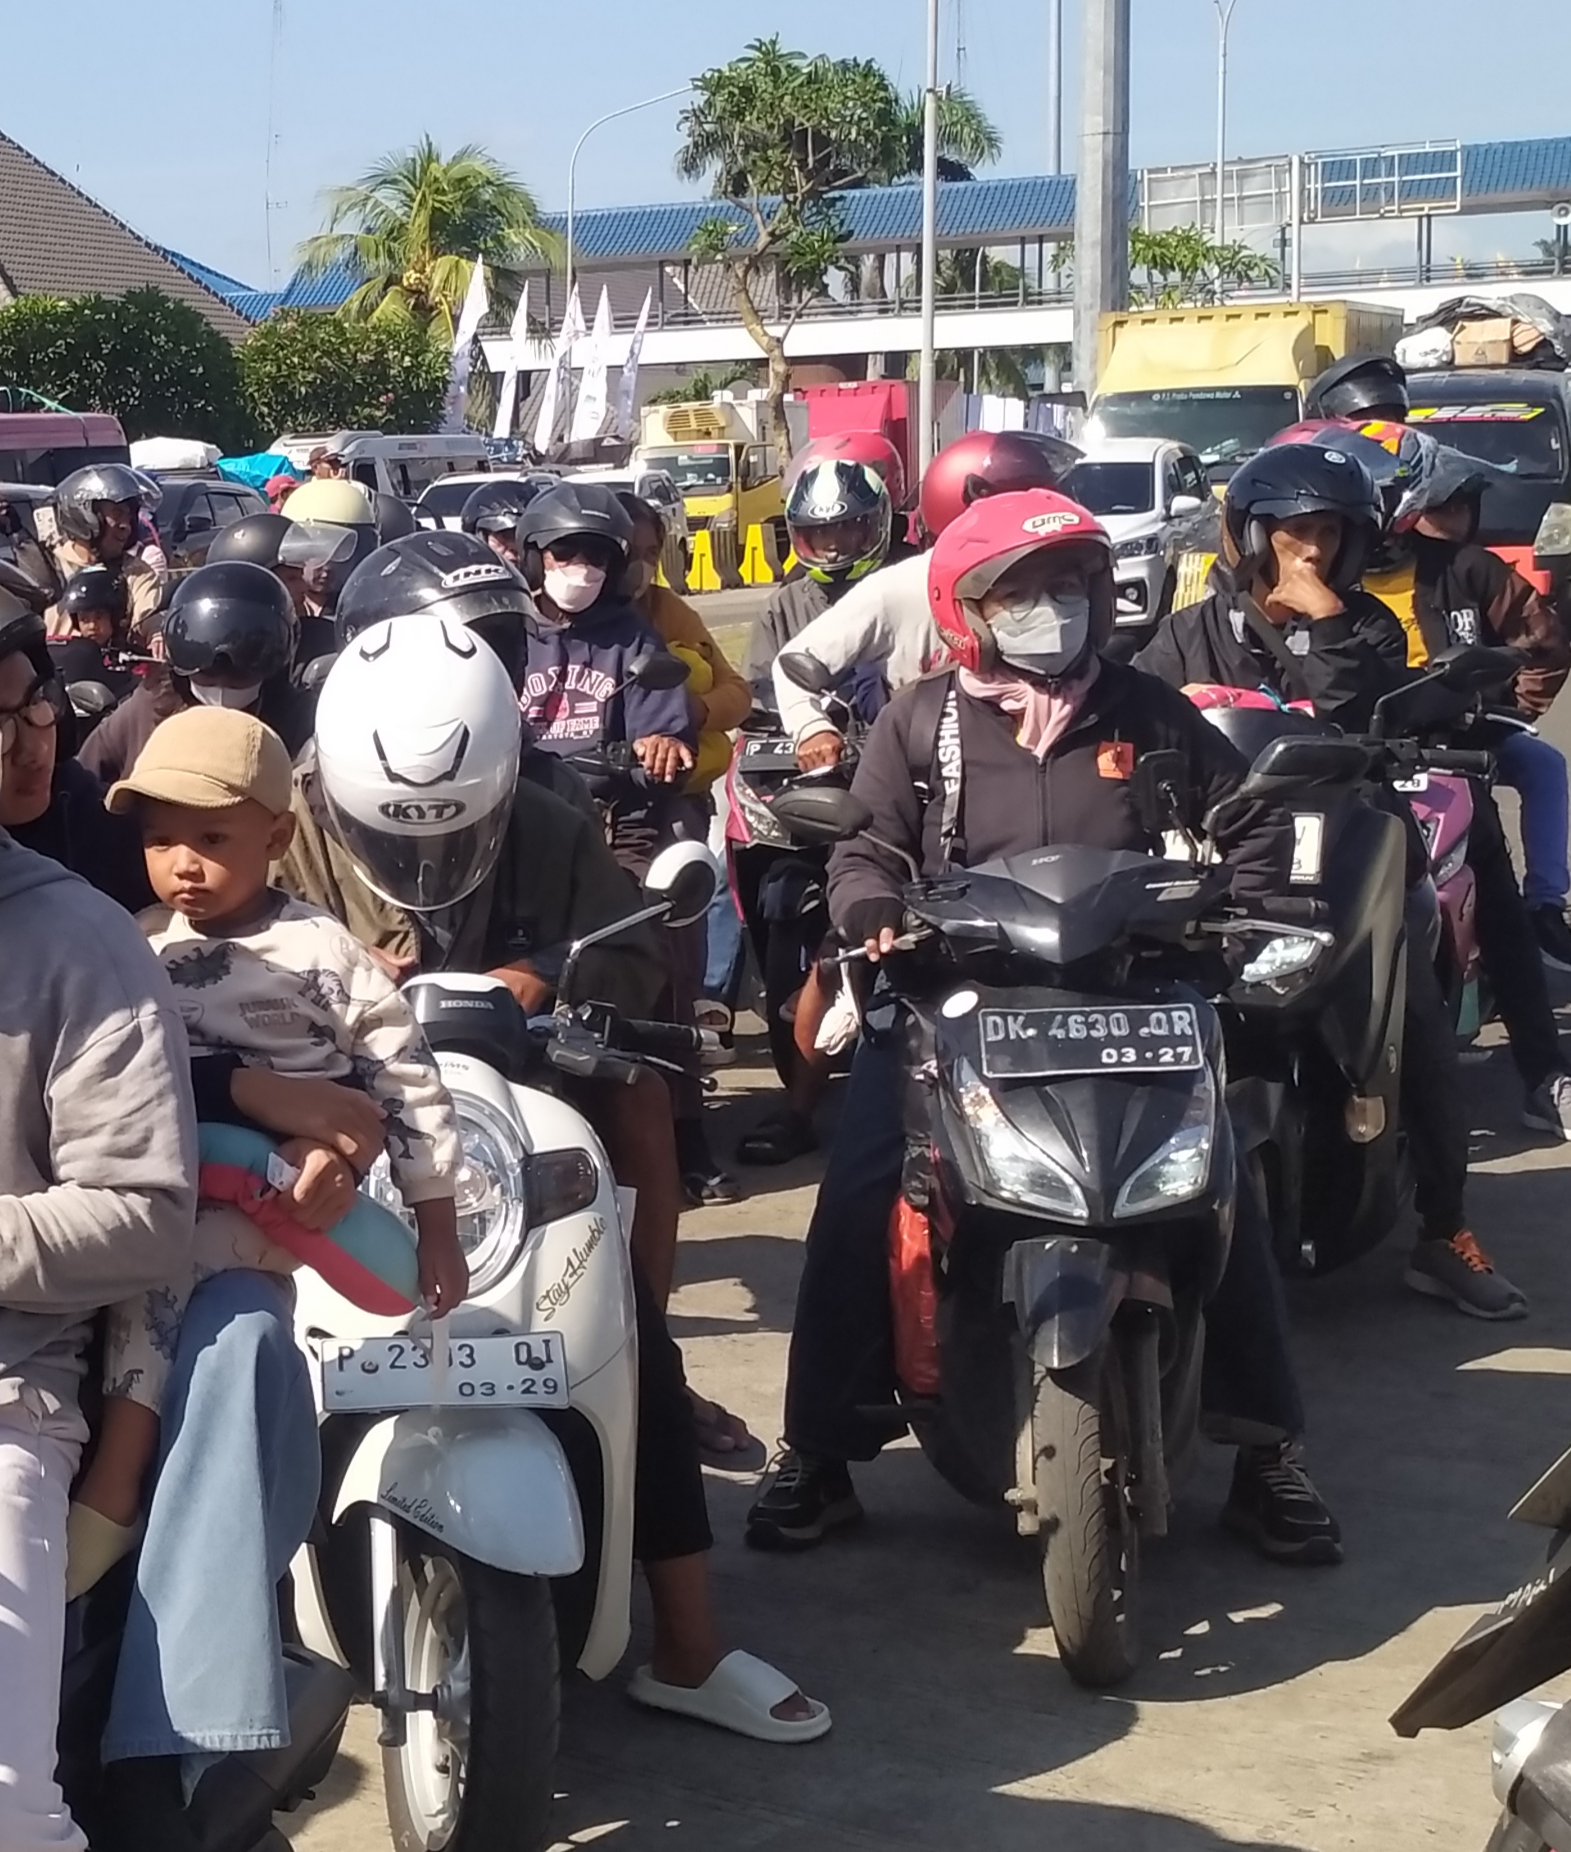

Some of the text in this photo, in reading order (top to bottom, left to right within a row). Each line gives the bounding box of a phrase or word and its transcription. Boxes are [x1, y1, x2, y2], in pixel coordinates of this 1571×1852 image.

[450, 567, 506, 582] INK
[773, 743, 795, 754] 43
[391, 803, 455, 820] KYT
[439, 999, 495, 1010] HONDA
[985, 1014, 1028, 1042] DK
[565, 1216, 607, 1280] Humble
[337, 1346, 355, 1372] P
[387, 1343, 477, 1370] 233
